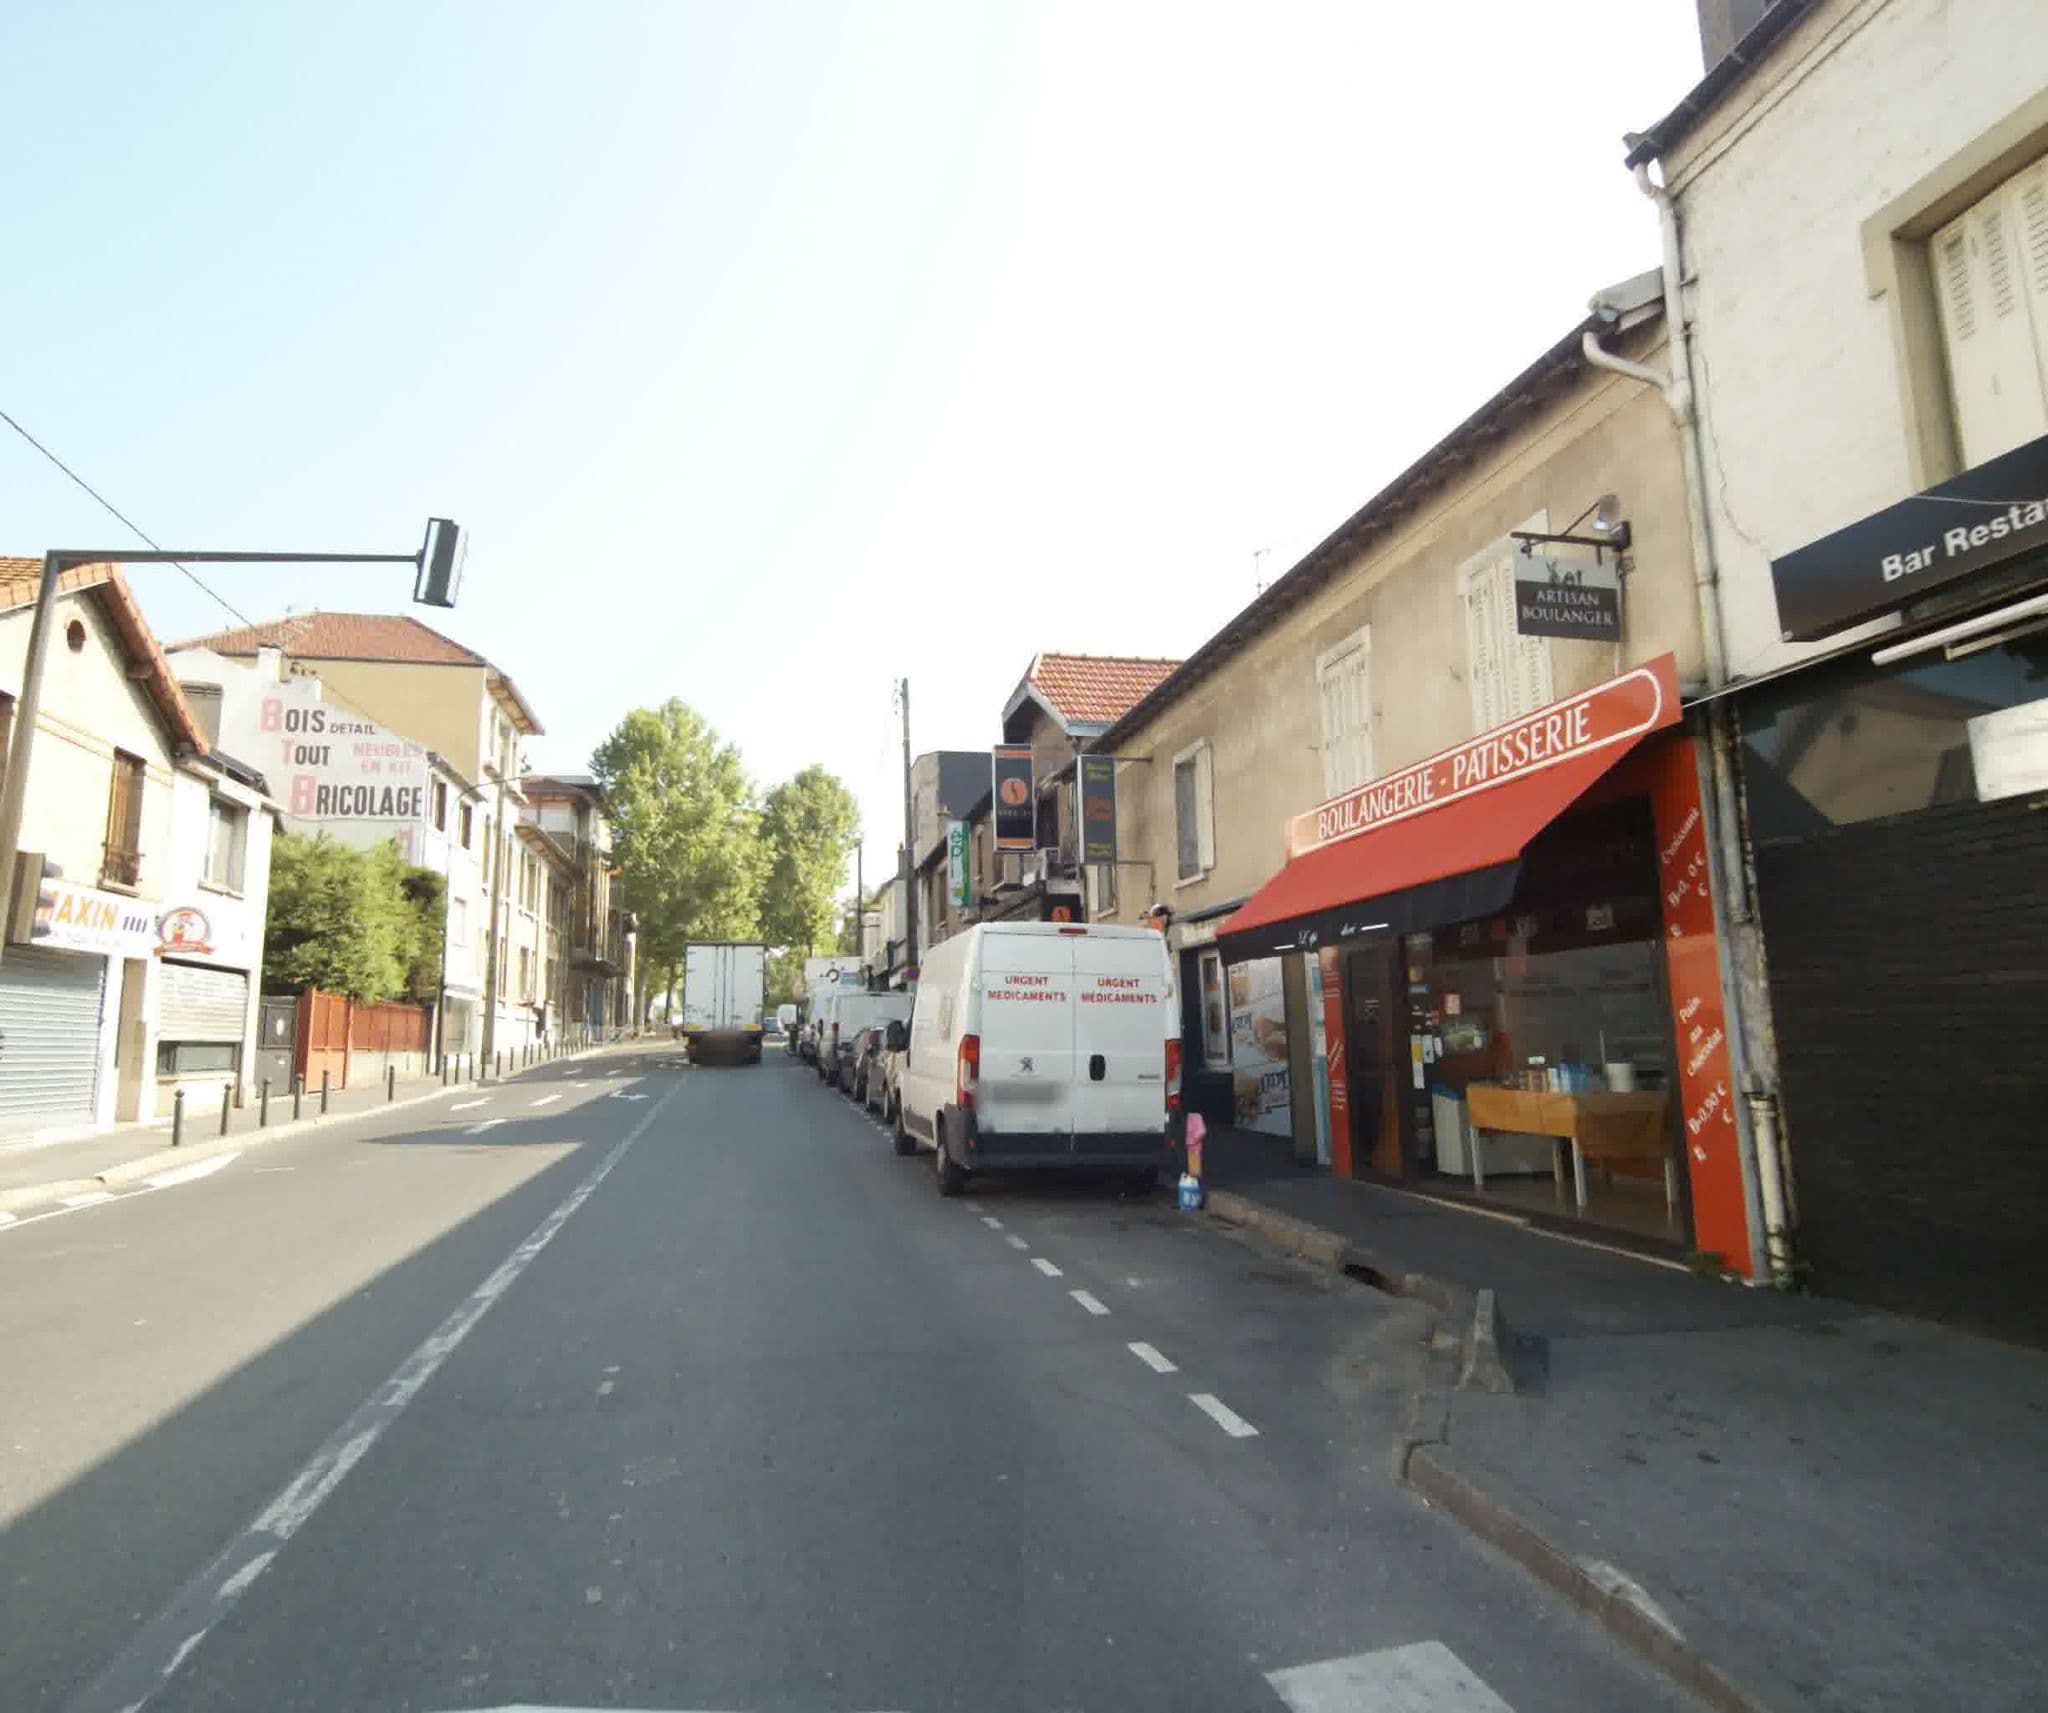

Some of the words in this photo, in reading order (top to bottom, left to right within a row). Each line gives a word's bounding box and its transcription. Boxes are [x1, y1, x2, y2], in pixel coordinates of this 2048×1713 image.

[1881, 545, 1936, 582] Bar
[1536, 589, 1601, 607] ARTISAN
[1521, 605, 1614, 625] BOULANGER
[260, 698, 326, 733] BOIS
[281, 738, 331, 766] TOUT
[1317, 767, 1435, 840] BOULANGERIE
[1453, 702, 1592, 790] PATISSERIE
[289, 774, 423, 818] BRICOLAGE
[1005, 976, 1049, 986] URGENT
[1097, 977, 1140, 988] URGENT
